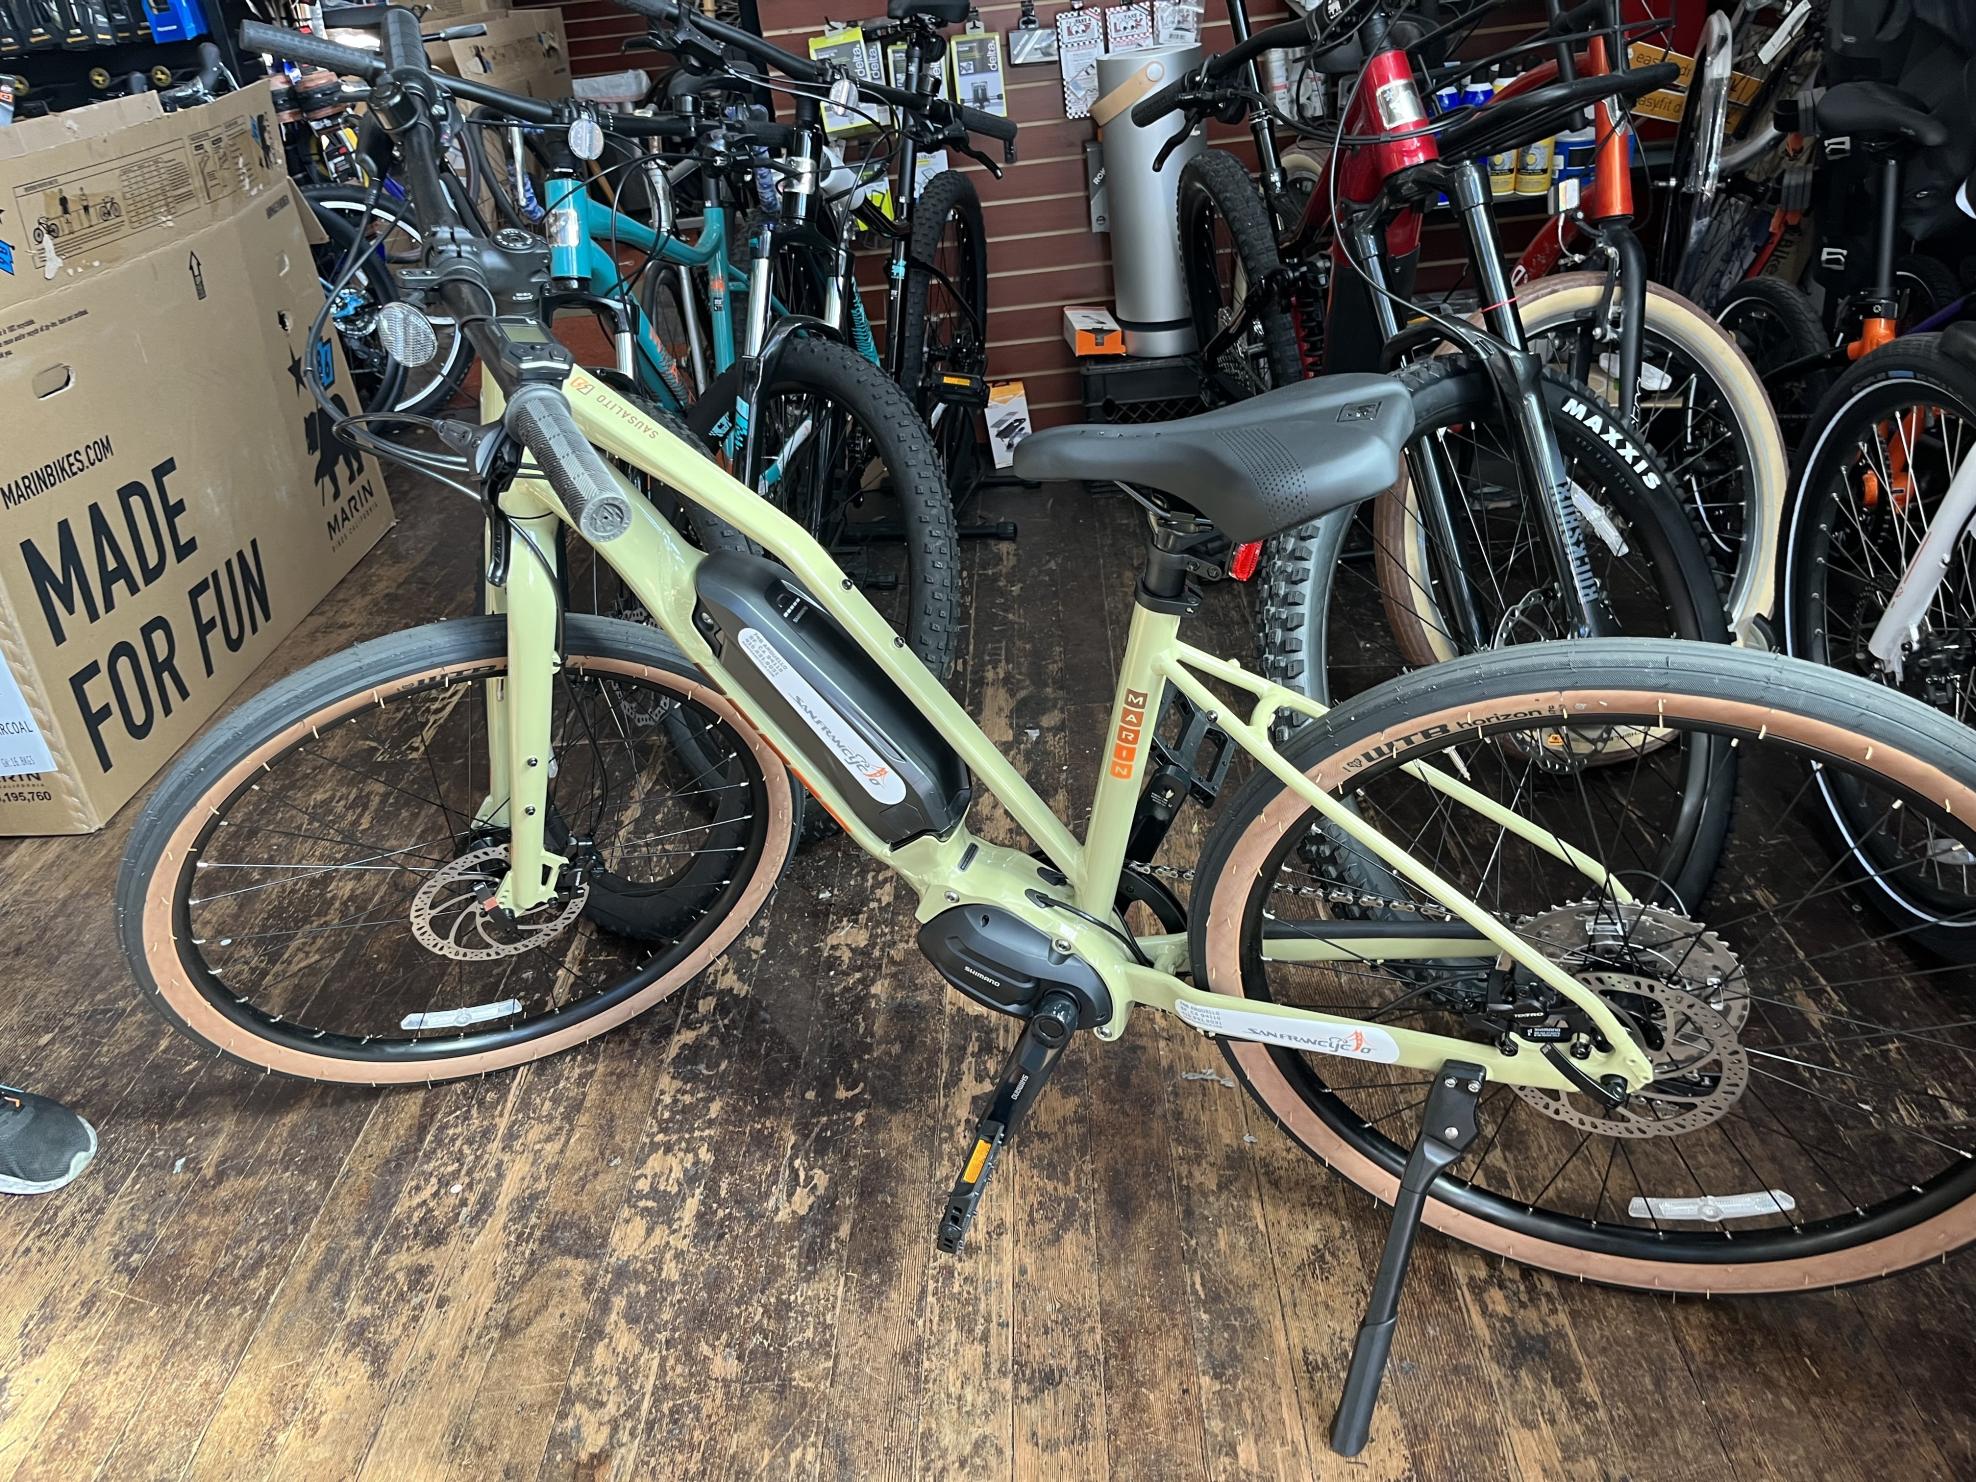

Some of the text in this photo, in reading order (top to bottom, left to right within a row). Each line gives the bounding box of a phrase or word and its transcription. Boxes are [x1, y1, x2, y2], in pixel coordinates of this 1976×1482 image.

[1637, 95, 1672, 112] asyfit
[596, 394, 659, 439] SAUSALITO
[1561, 398, 1661, 490] MAXXIS
[0, 434, 114, 510] MARINBIKES.COM
[327, 480, 374, 541] MARIN
[20, 456, 198, 647] MADE
[187, 537, 271, 679] FUN
[68, 615, 190, 774] FOR
[0, 719, 34, 737] RCOAL
[1115, 693, 1144, 776] MARIN
[1361, 723, 1450, 764] WTB
[1456, 708, 1543, 730] horizon
[0, 790, 52, 803] ,195,760
[964, 965, 1001, 987] SHIMANO
